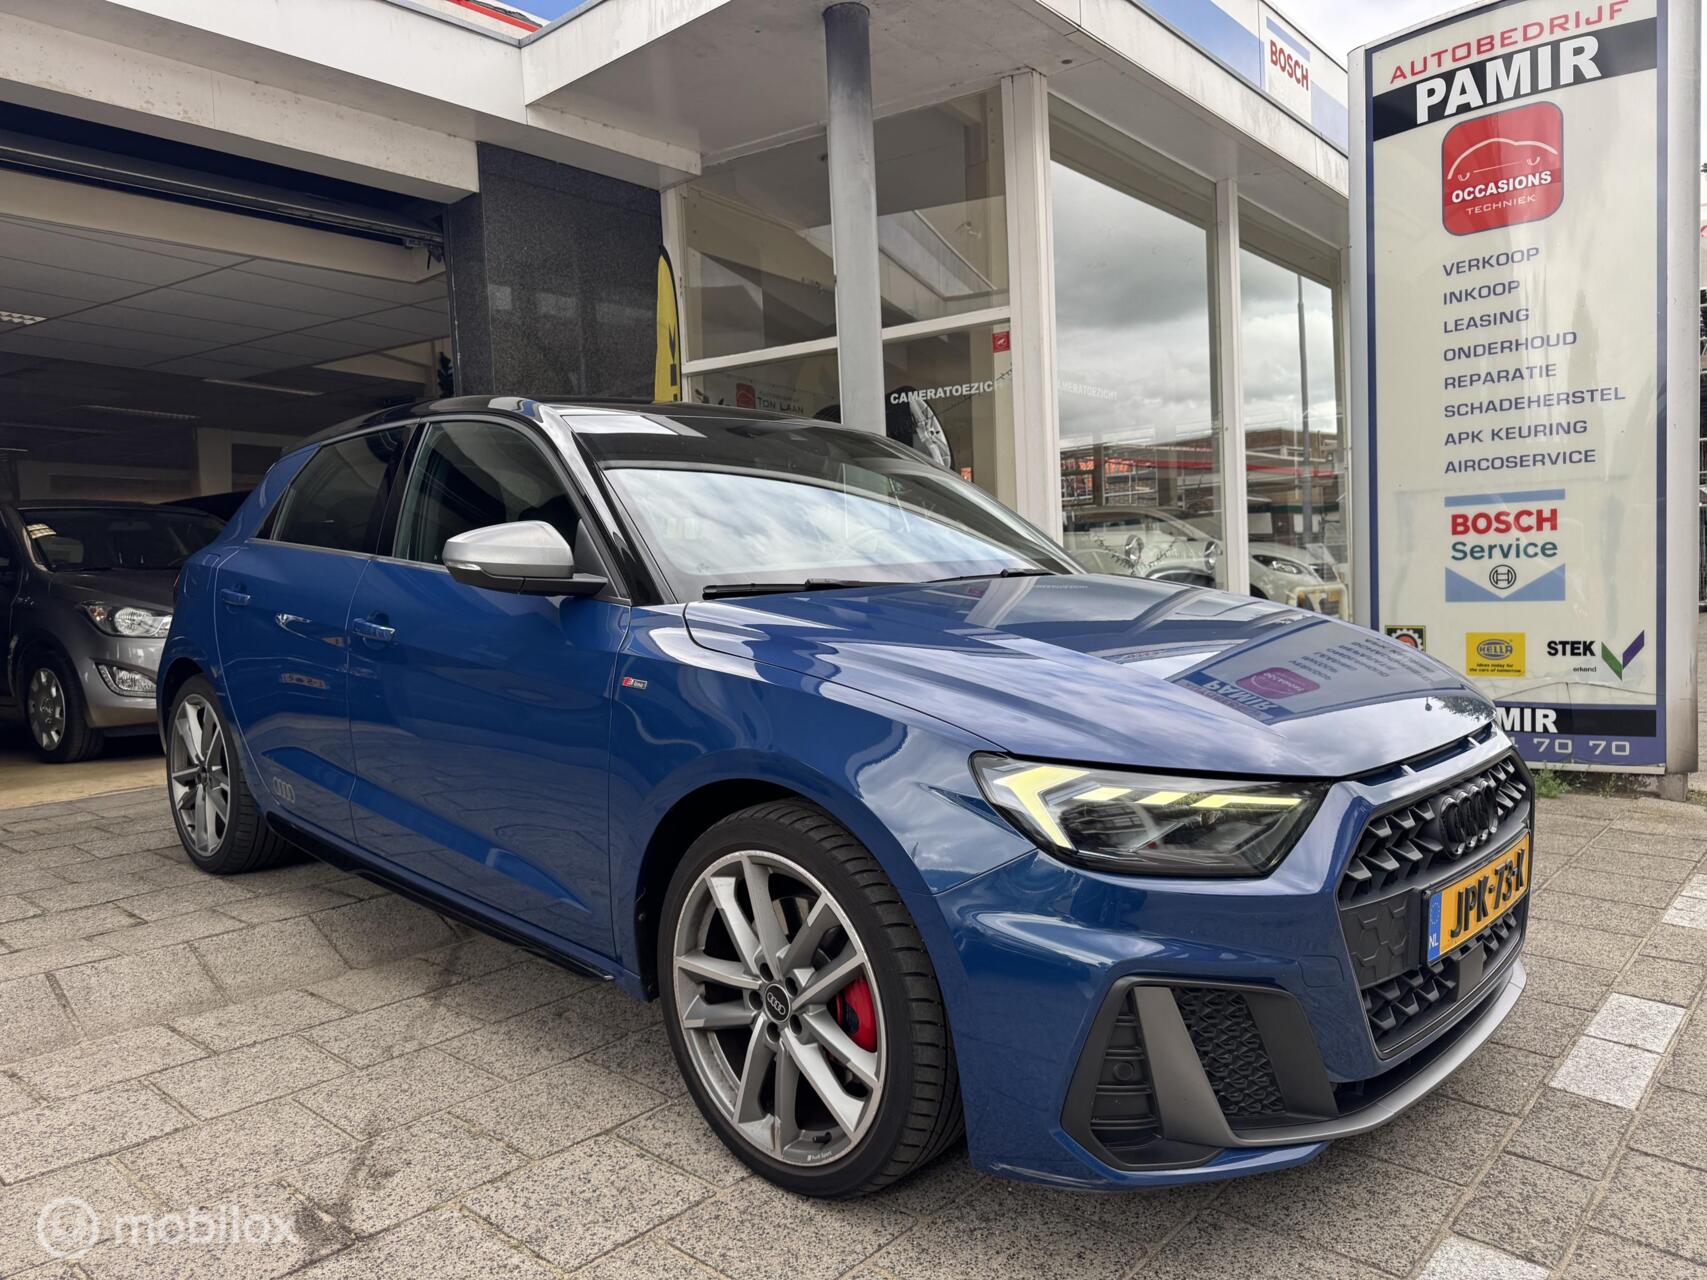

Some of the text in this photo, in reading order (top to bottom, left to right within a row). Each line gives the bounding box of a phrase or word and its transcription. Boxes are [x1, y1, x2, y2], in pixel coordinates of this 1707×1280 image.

[1390, 0, 1629, 84] AUTOBEDRIJF
[1270, 39, 1309, 91] BOSCH
[1416, 36, 1602, 125] PAMIR
[1451, 170, 1552, 204] OCCASIONS
[1465, 194, 1536, 215] TECHNIEK
[1443, 247, 1539, 277] VERKOOP
[1443, 280, 1520, 305] INKOOP
[1443, 308, 1530, 333] LEASING
[1443, 331, 1577, 362] ONDERHOUD
[1444, 363, 1557, 390] REPARATIE
[890, 380, 998, 405] CAMERATOEZIC
[1444, 387, 1626, 418] SCHADEHERSTEL
[1444, 420, 1588, 446] APK KEURING
[1444, 449, 1596, 474] AIRCOSERVICE
[1451, 508, 1558, 536] BOSCH
[1451, 538, 1558, 561] Service
[1546, 640, 1596, 657] STEK
[1533, 738, 1572, 754] 70
[1589, 740, 1630, 756] 70
[1450, 848, 1525, 938] JPK-73-K
[1429, 932, 1439, 948] NL
